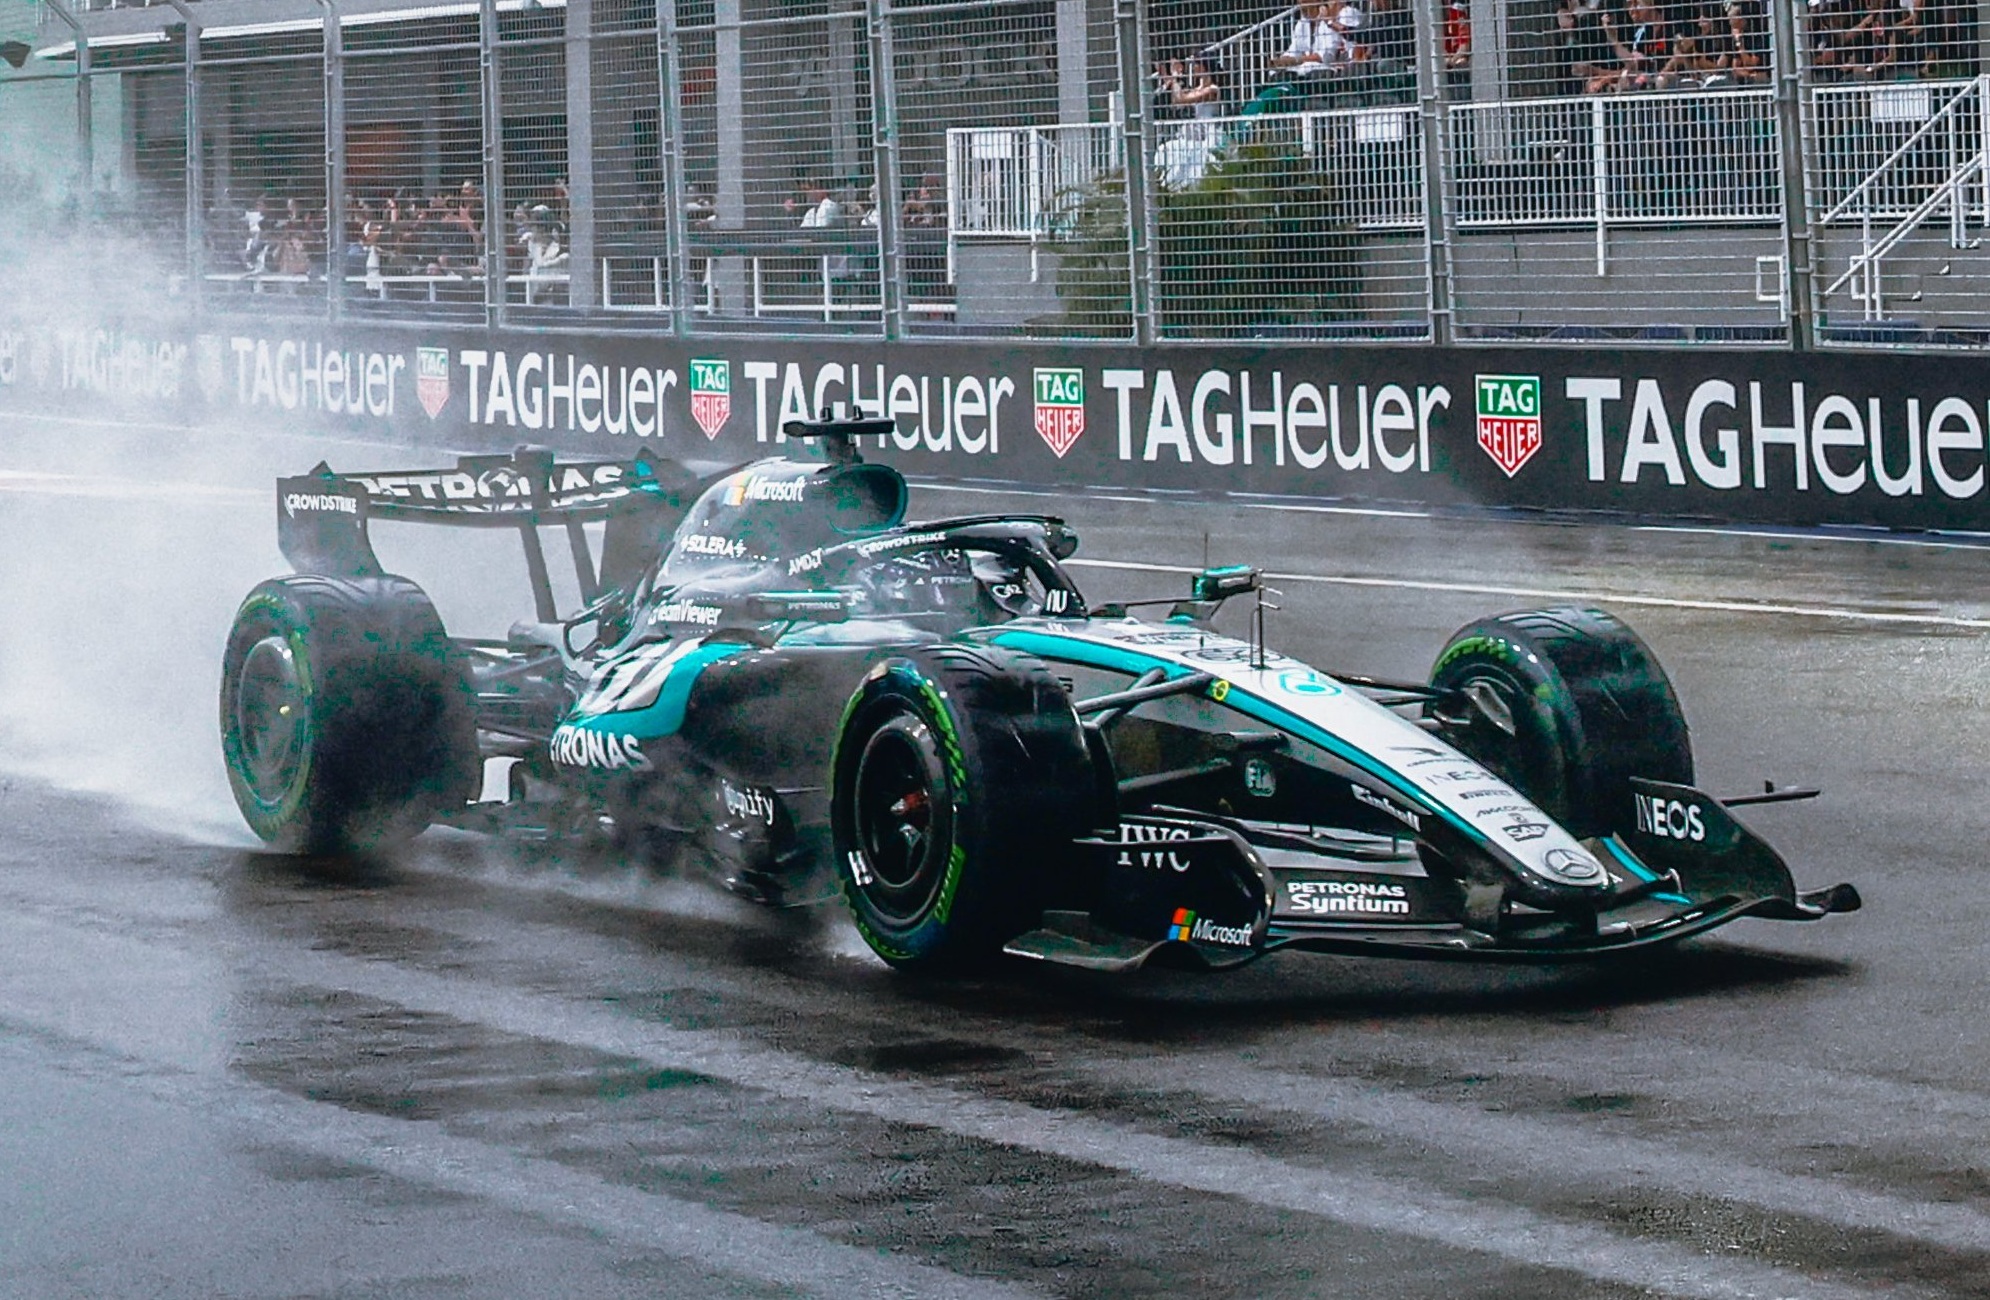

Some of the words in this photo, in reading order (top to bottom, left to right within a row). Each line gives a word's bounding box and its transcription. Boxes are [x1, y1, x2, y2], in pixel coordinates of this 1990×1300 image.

[420, 352, 446, 376] TAG
[693, 365, 726, 390] TAG
[1037, 374, 1079, 401] TAG
[1480, 382, 1535, 413] TAG
[692, 396, 728, 434] HEUER
[1037, 408, 1081, 451] HEUER
[1480, 421, 1538, 469] HEUER
[1565, 376, 1990, 499] TAGHeue
[745, 475, 805, 502] Microsoft
[686, 535, 735, 558] SOLERA
[1634, 792, 1706, 841] INEOS
[1117, 823, 1191, 872] IWC
[1287, 882, 1406, 897] PETRONAS
[1290, 893, 1410, 914] Syntium
[1191, 917, 1254, 946] Microsoft
